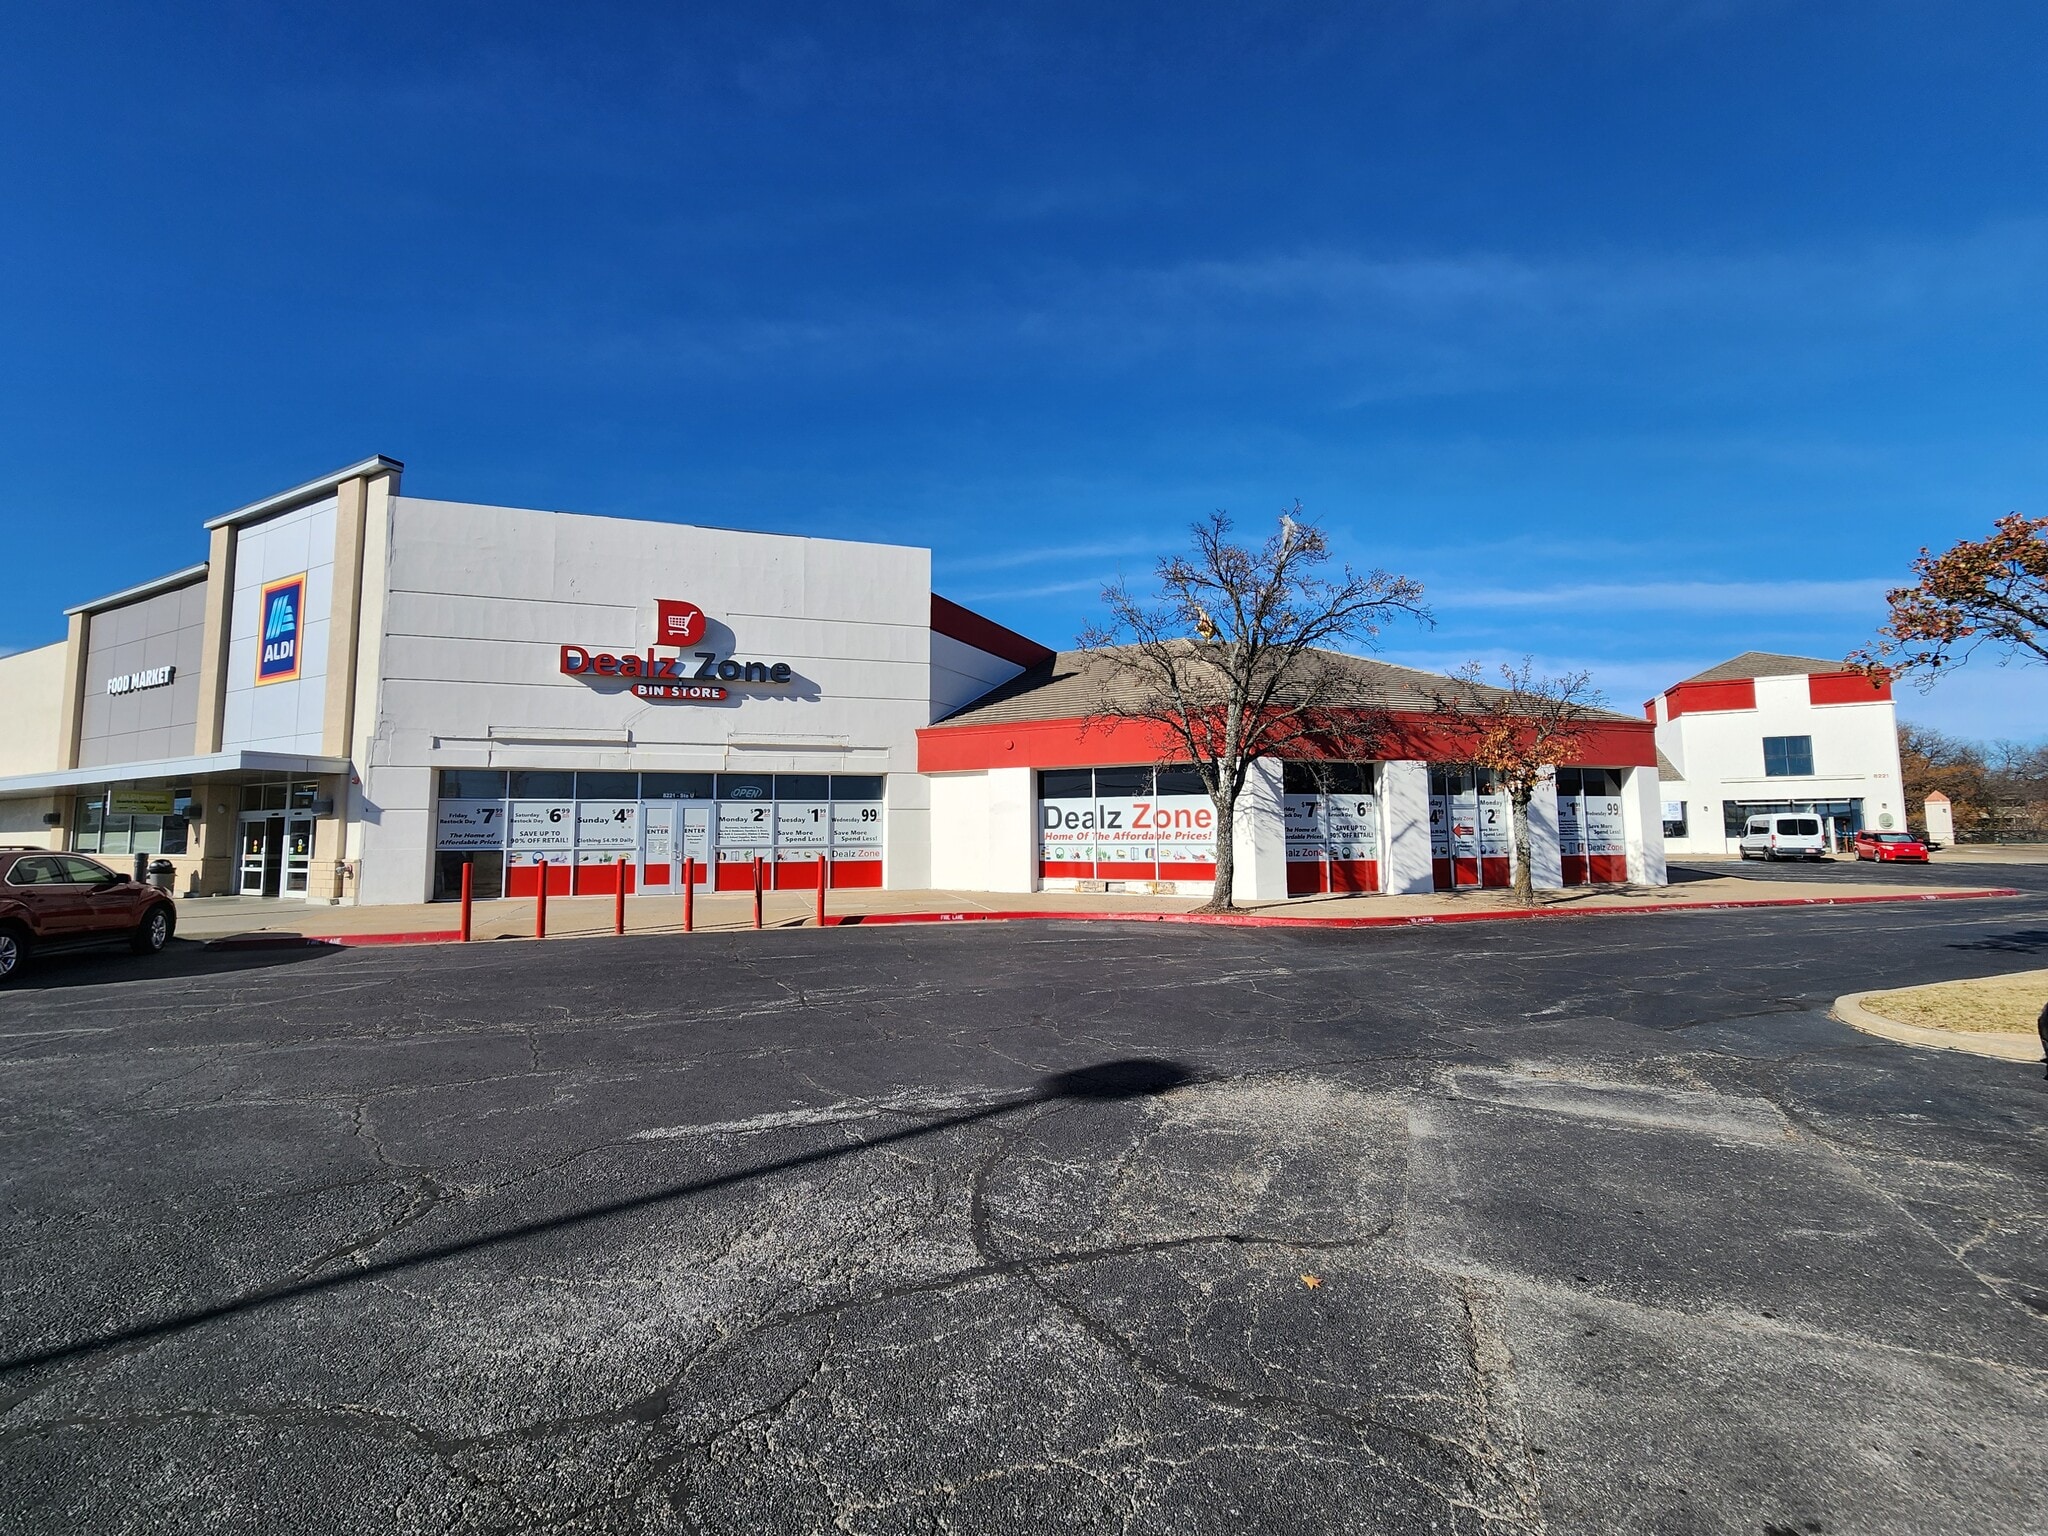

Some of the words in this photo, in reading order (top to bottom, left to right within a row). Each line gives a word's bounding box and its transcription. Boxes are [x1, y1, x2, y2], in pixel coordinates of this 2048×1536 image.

[263, 639, 295, 662] ALDI
[560, 645, 677, 679] Dealz
[693, 652, 791, 683] Zone
[107, 674, 130, 694] FOOD
[131, 666, 173, 690] MARKET
[637, 685, 664, 696] BIN
[671, 686, 720, 698] STORE
[733, 788, 760, 798] OPEN
[1043, 804, 1122, 830] Dealz
[1132, 803, 1212, 829] Zone
[1045, 832, 1074, 841] Home
[1076, 832, 1090, 841] Of
[1113, 831, 1172, 841] Affordable
[1174, 831, 1212, 840] Prices!
[1302, 848, 1324, 857] Zone
[1588, 843, 1605, 851] Dealz
[1607, 843, 1624, 851] Zone
[831, 850, 856, 858] Dealz
[858, 849, 880, 857] Zone
